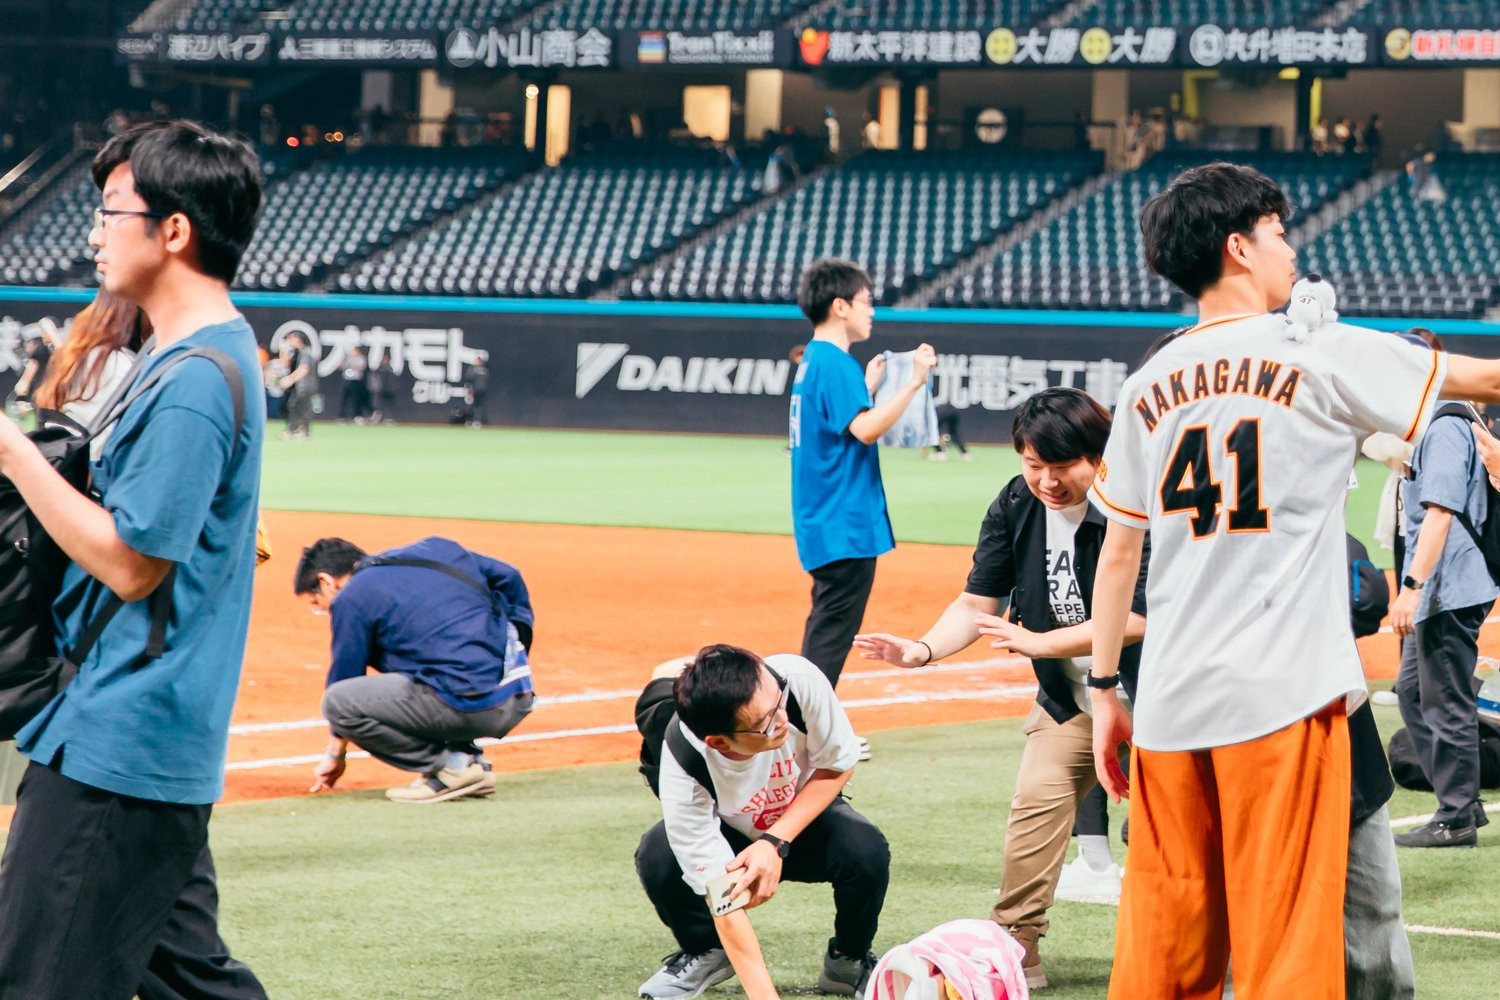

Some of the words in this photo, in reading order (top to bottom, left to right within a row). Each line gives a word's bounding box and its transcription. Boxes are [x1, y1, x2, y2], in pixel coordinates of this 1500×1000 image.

[475, 26, 612, 67] 小山商会
[827, 29, 982, 63] 新太平洋建設
[318, 325, 490, 383] オカモト
[616, 354, 791, 396] DAIKIN
[1135, 357, 1302, 434] NAKAGAWA
[1159, 416, 1271, 541] 41
